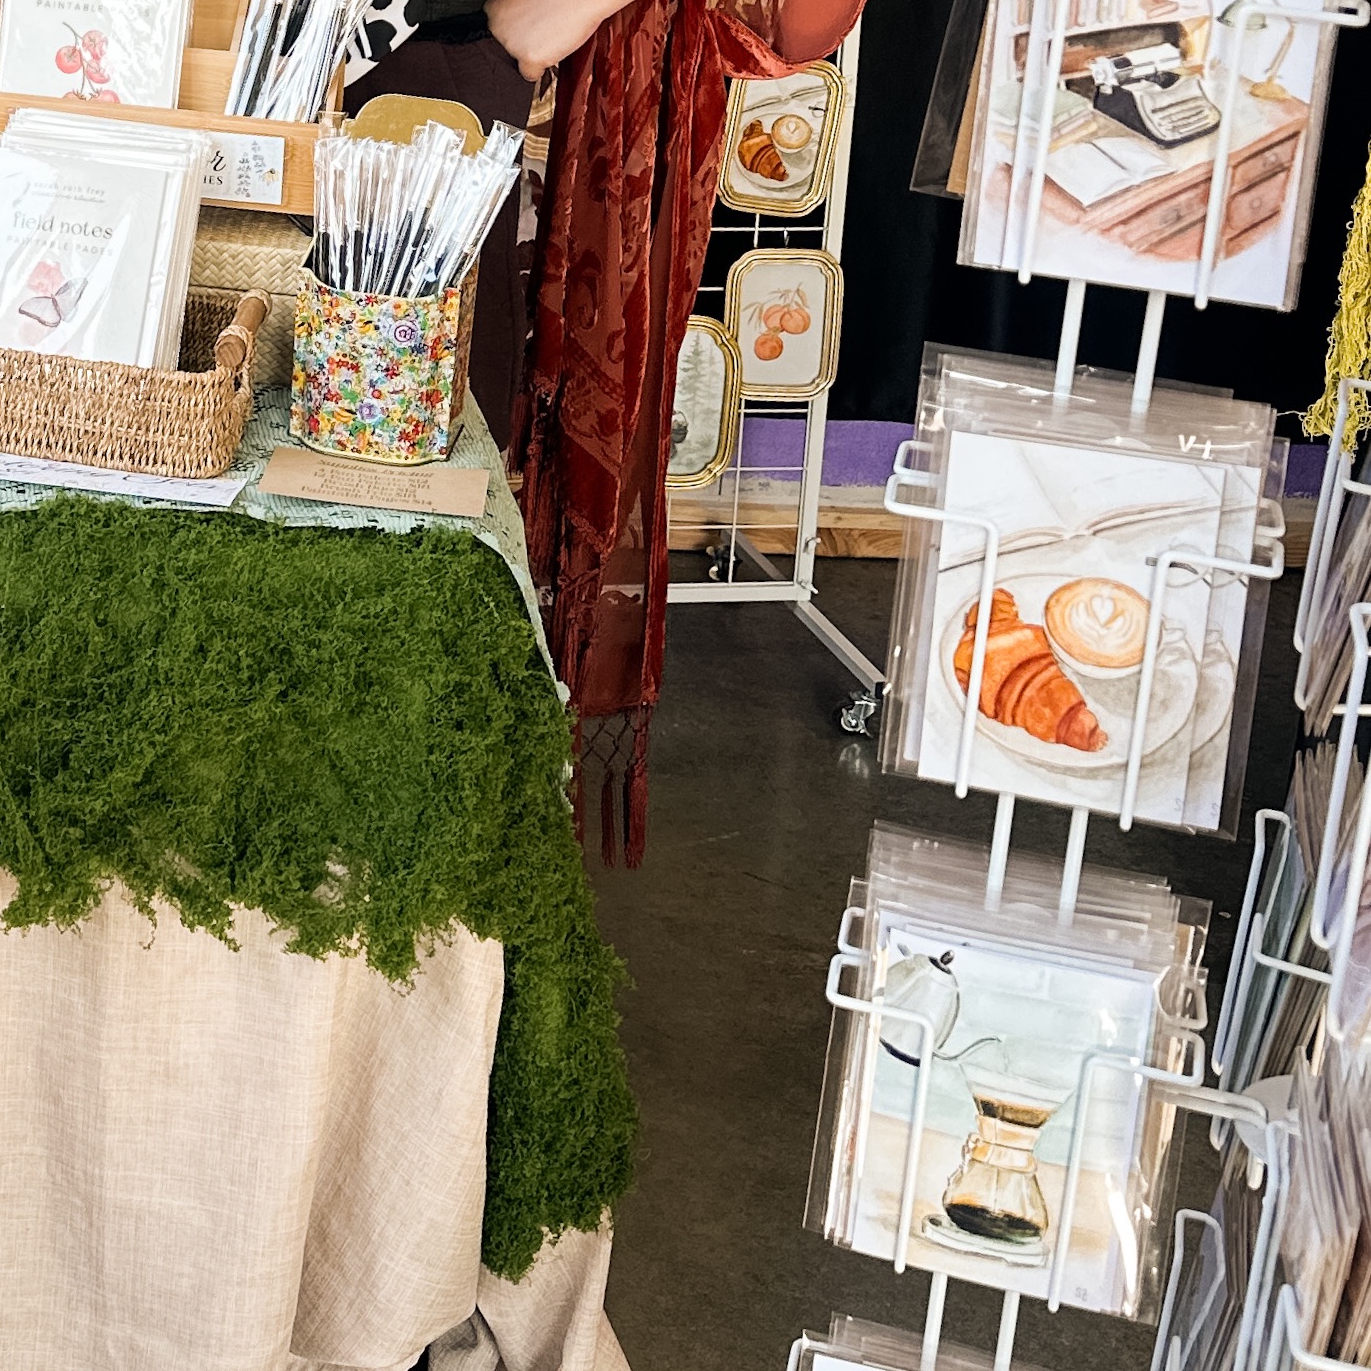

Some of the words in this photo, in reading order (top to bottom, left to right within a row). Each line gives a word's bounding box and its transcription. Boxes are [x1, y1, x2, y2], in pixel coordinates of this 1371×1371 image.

[36, 0, 106, 14] PAINTABLE
[13, 210, 55, 233] field
[59, 221, 114, 240] notes
[75, 243, 113, 257] PAGES
